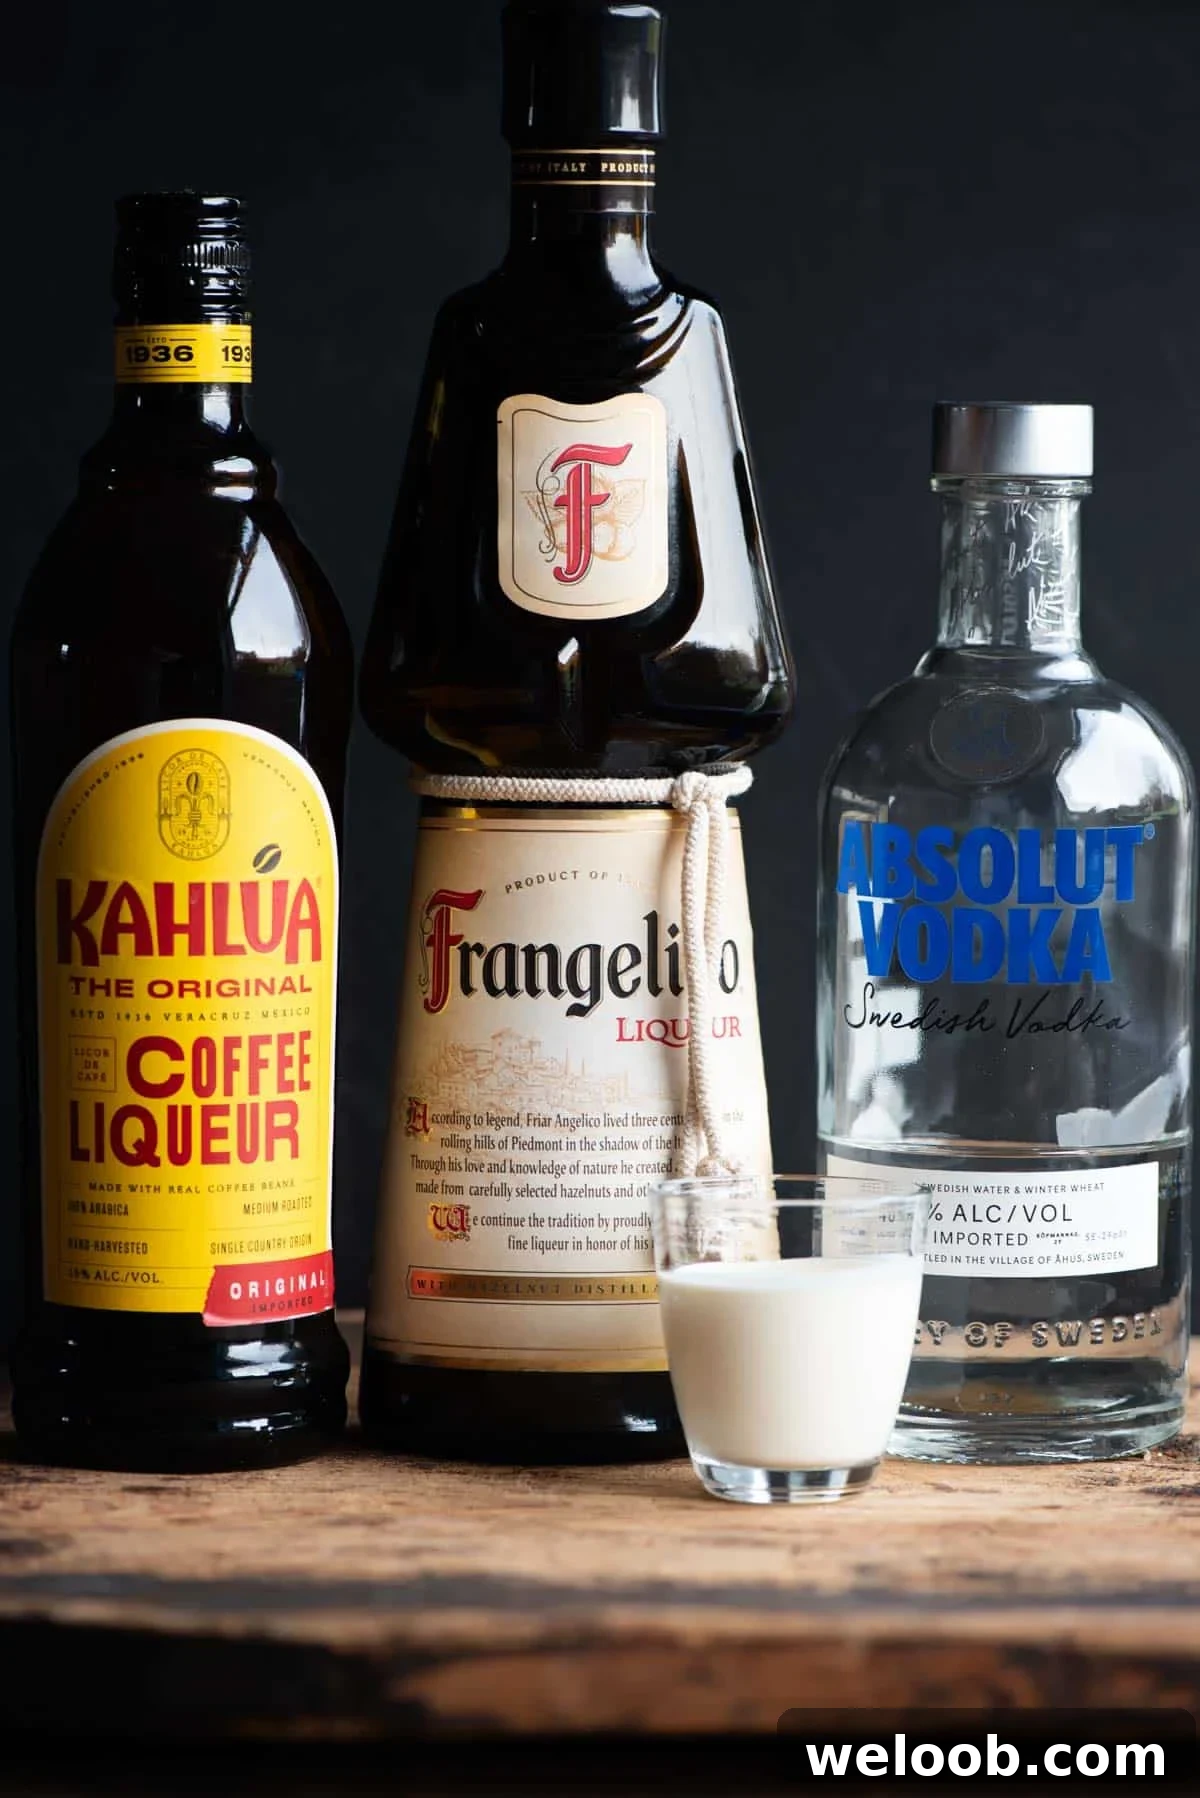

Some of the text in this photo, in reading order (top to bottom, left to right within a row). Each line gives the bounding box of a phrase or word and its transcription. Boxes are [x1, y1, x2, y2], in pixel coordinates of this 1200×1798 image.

[126, 345, 194, 363] 1936
[837, 822, 1145, 905] ABSOLUT
[504, 869, 579, 894] PRODUCT
[418, 886, 742, 1018] Frangelio
[858, 900, 1113, 985] VODKA
[69, 974, 312, 999] THE ORIGINAL
[163, 1011, 250, 1022] VERACRUZ
[844, 982, 1131, 1039] Swedish Vodka
[615, 1016, 742, 1049] LIQUUR
[126, 1030, 312, 1100] COFFEE
[474, 1113, 484, 1126] to
[486, 1111, 523, 1131] legend,
[526, 1112, 553, 1128] Friar
[555, 1112, 601, 1132] Angelico
[603, 1112, 629, 1128] lived
[631, 1112, 658, 1127] three
[70, 1099, 299, 1168] LIQUEUR
[440, 1133, 472, 1153] rolling
[474, 1134, 496, 1150] hills
[498, 1135, 509, 1150] of
[511, 1135, 563, 1152] Piedmont
[566, 1136, 577, 1151] in
[580, 1136, 597, 1151] the
[599, 1135, 639, 1151] shadow
[642, 1134, 653, 1150] of
[655, 1135, 672, 1150] the
[410, 1154, 446, 1175] Through
[448, 1155, 463, 1172] his
[464, 1157, 485, 1173] love
[487, 1158, 507, 1174] and
[509, 1159, 567, 1179] knowledge
[569, 1159, 581, 1174] of
[583, 1160, 618, 1174] nature
[621, 1159, 634, 1174] he
[635, 1158, 673, 1174] created
[88, 1182, 122, 1193] MADE
[128, 1184, 161, 1194] WITH
[168, 1185, 201, 1195] REAL
[208, 1182, 256, 1194] COFFEE
[415, 1179, 439, 1195] made
[440, 1179, 464, 1195] from
[469, 1181, 512, 1202] carefully
[515, 1183, 558, 1198] selected
[560, 1183, 611, 1198] hazelnuts
[613, 1182, 634, 1198] and
[922, 1182, 1105, 1194] WEDISH WATER & WINTER WHEAT
[89, 1203, 129, 1217] ARABICA
[243, 1200, 280, 1216] MEDIUM
[481, 1212, 526, 1228] continue
[528, 1212, 545, 1228] the
[548, 1212, 595, 1228] tradition
[598, 1212, 610, 1232] by
[210, 1232, 312, 1254] SINGLE COUNTRY ORIGIN
[508, 1234, 649, 1255] fine liqueur in honor of his
[933, 1230, 1028, 1247] IMPORTED
[951, 1255, 962, 1263] IN
[965, 1256, 985, 1264] THE
[989, 1256, 1034, 1265] VILLAGE
[1037, 1256, 1052, 1265] OF
[1087, 1251, 1124, 1262] SWEDEN
[229, 1269, 325, 1300] ORIGINAL
[252, 1295, 313, 1313] IMPORTED
[965, 1321, 1015, 1348] OF
